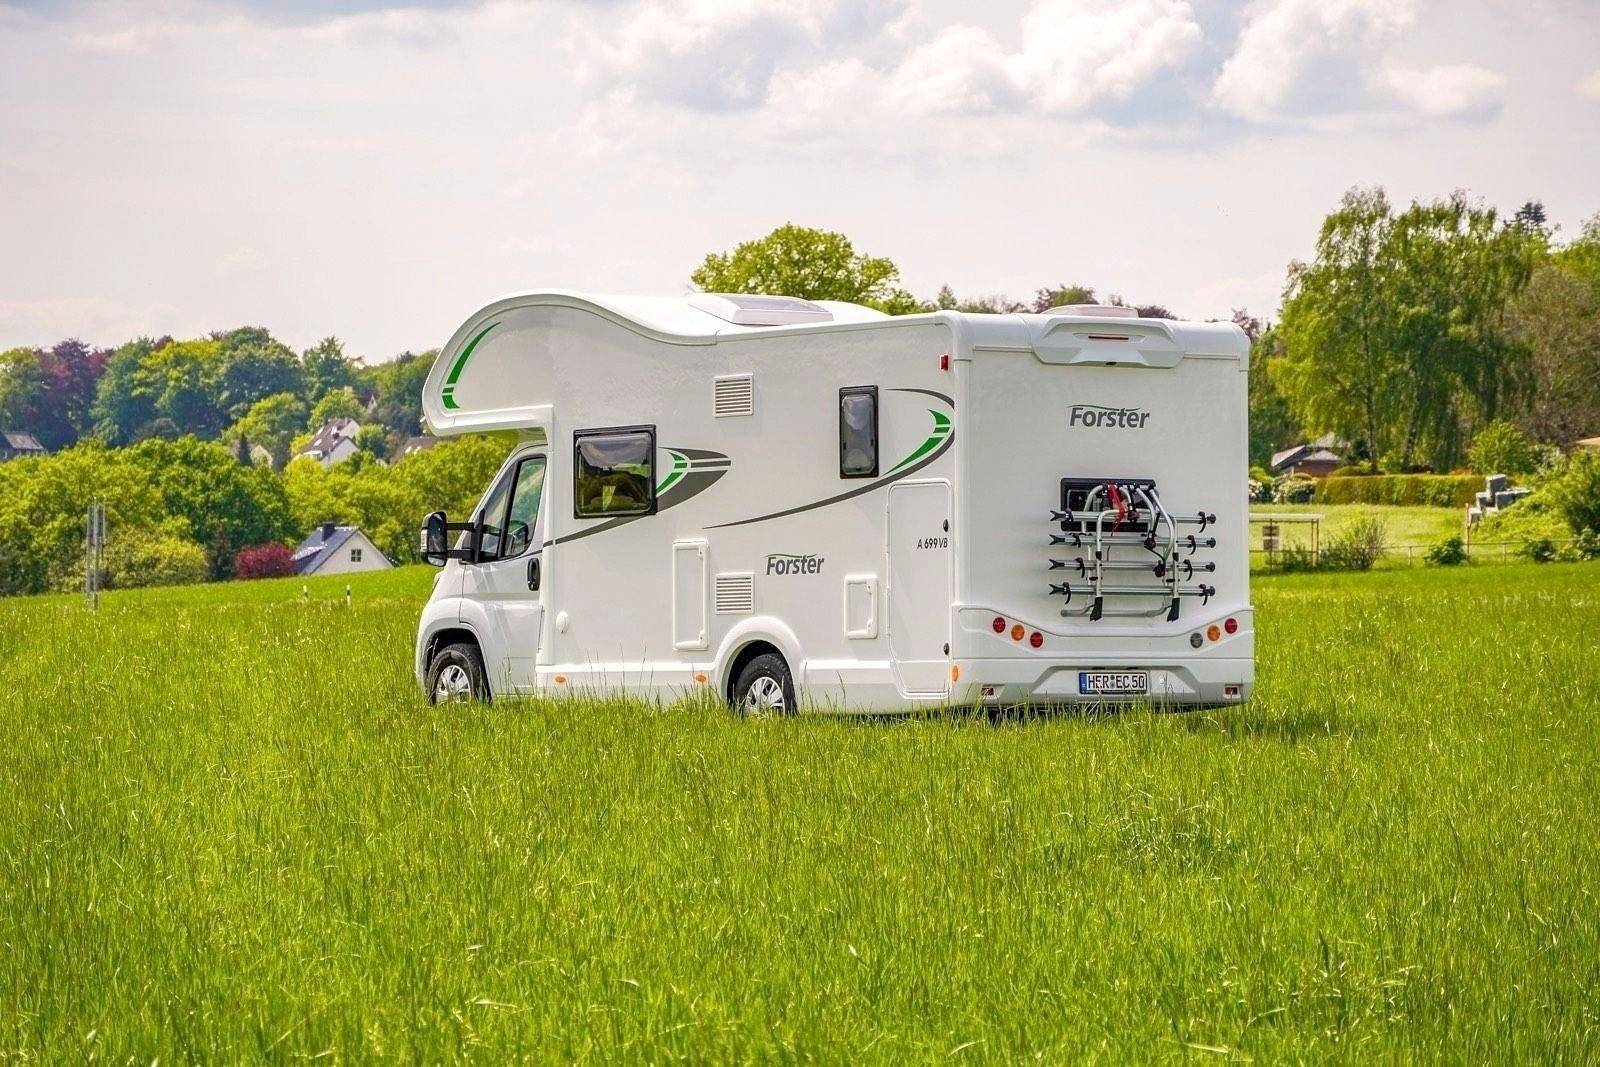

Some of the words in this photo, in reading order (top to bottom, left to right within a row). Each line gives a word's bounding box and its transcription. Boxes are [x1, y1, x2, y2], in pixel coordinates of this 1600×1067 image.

[1069, 407, 1150, 428] Forster
[916, 538, 923, 550] A
[766, 555, 825, 575] Forster
[1087, 675, 1109, 689] HER
